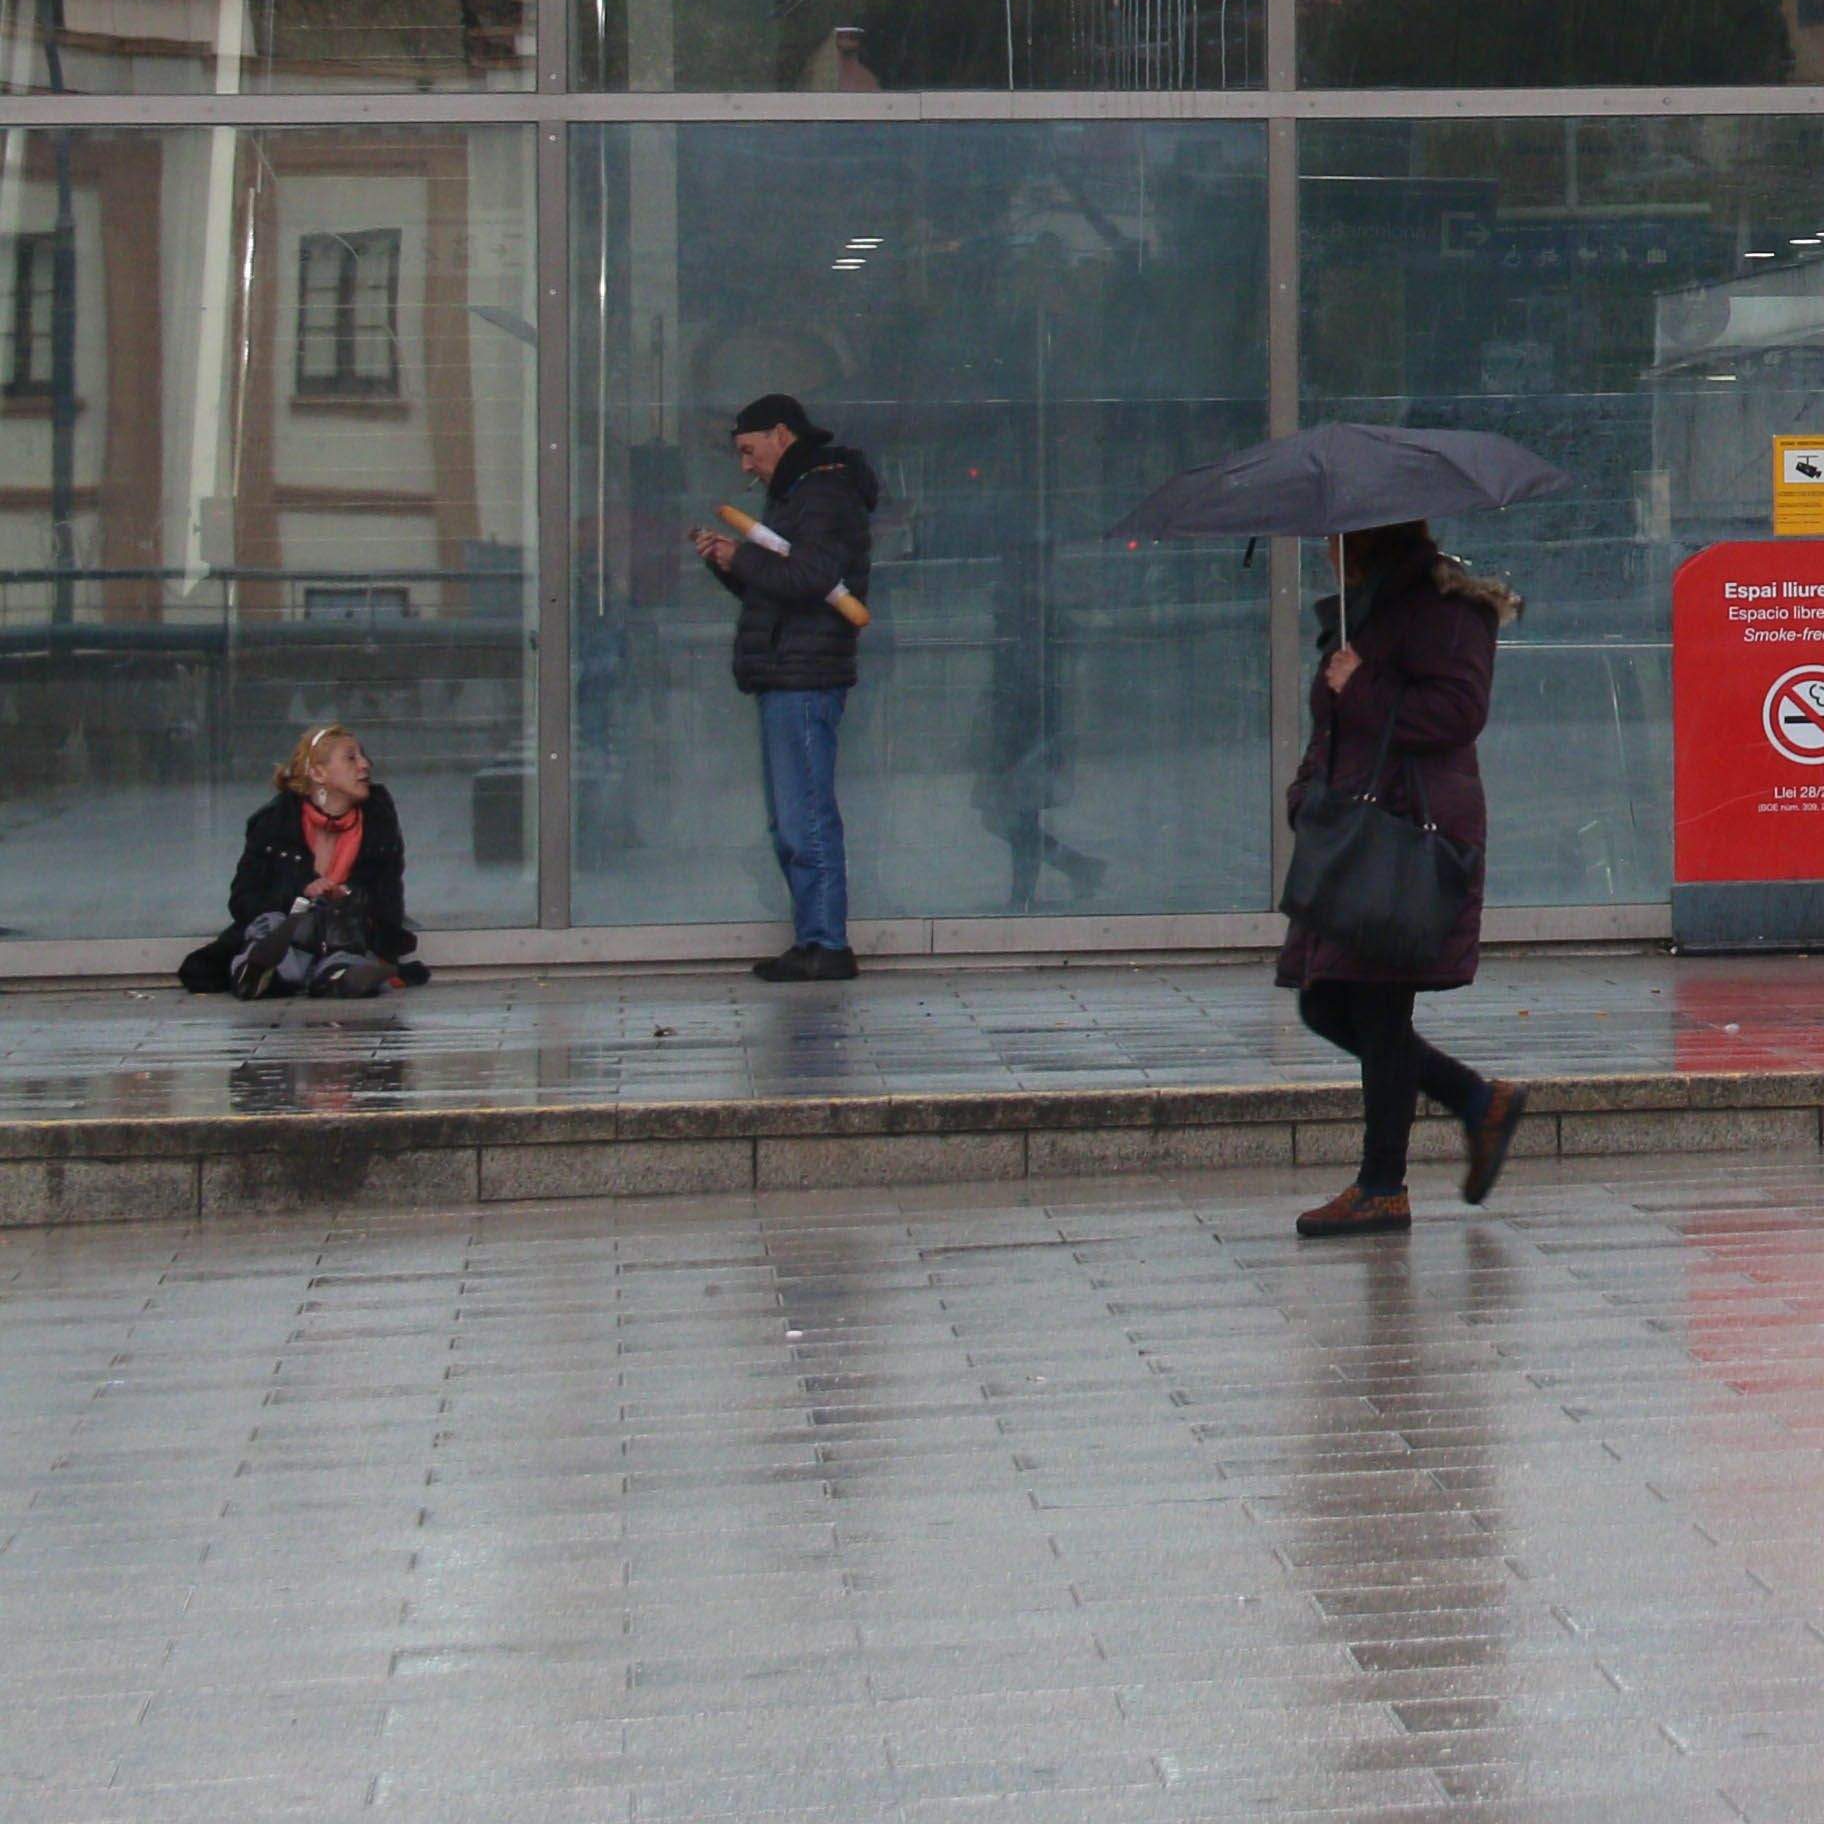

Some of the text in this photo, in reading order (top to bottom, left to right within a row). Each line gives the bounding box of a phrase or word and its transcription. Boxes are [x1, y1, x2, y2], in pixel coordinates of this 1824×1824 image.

[1724, 581, 1777, 601] Espai
[1728, 606, 1789, 623] Espacio
[1793, 606, 1824, 619] libre
[1774, 786, 1797, 799] Llei
